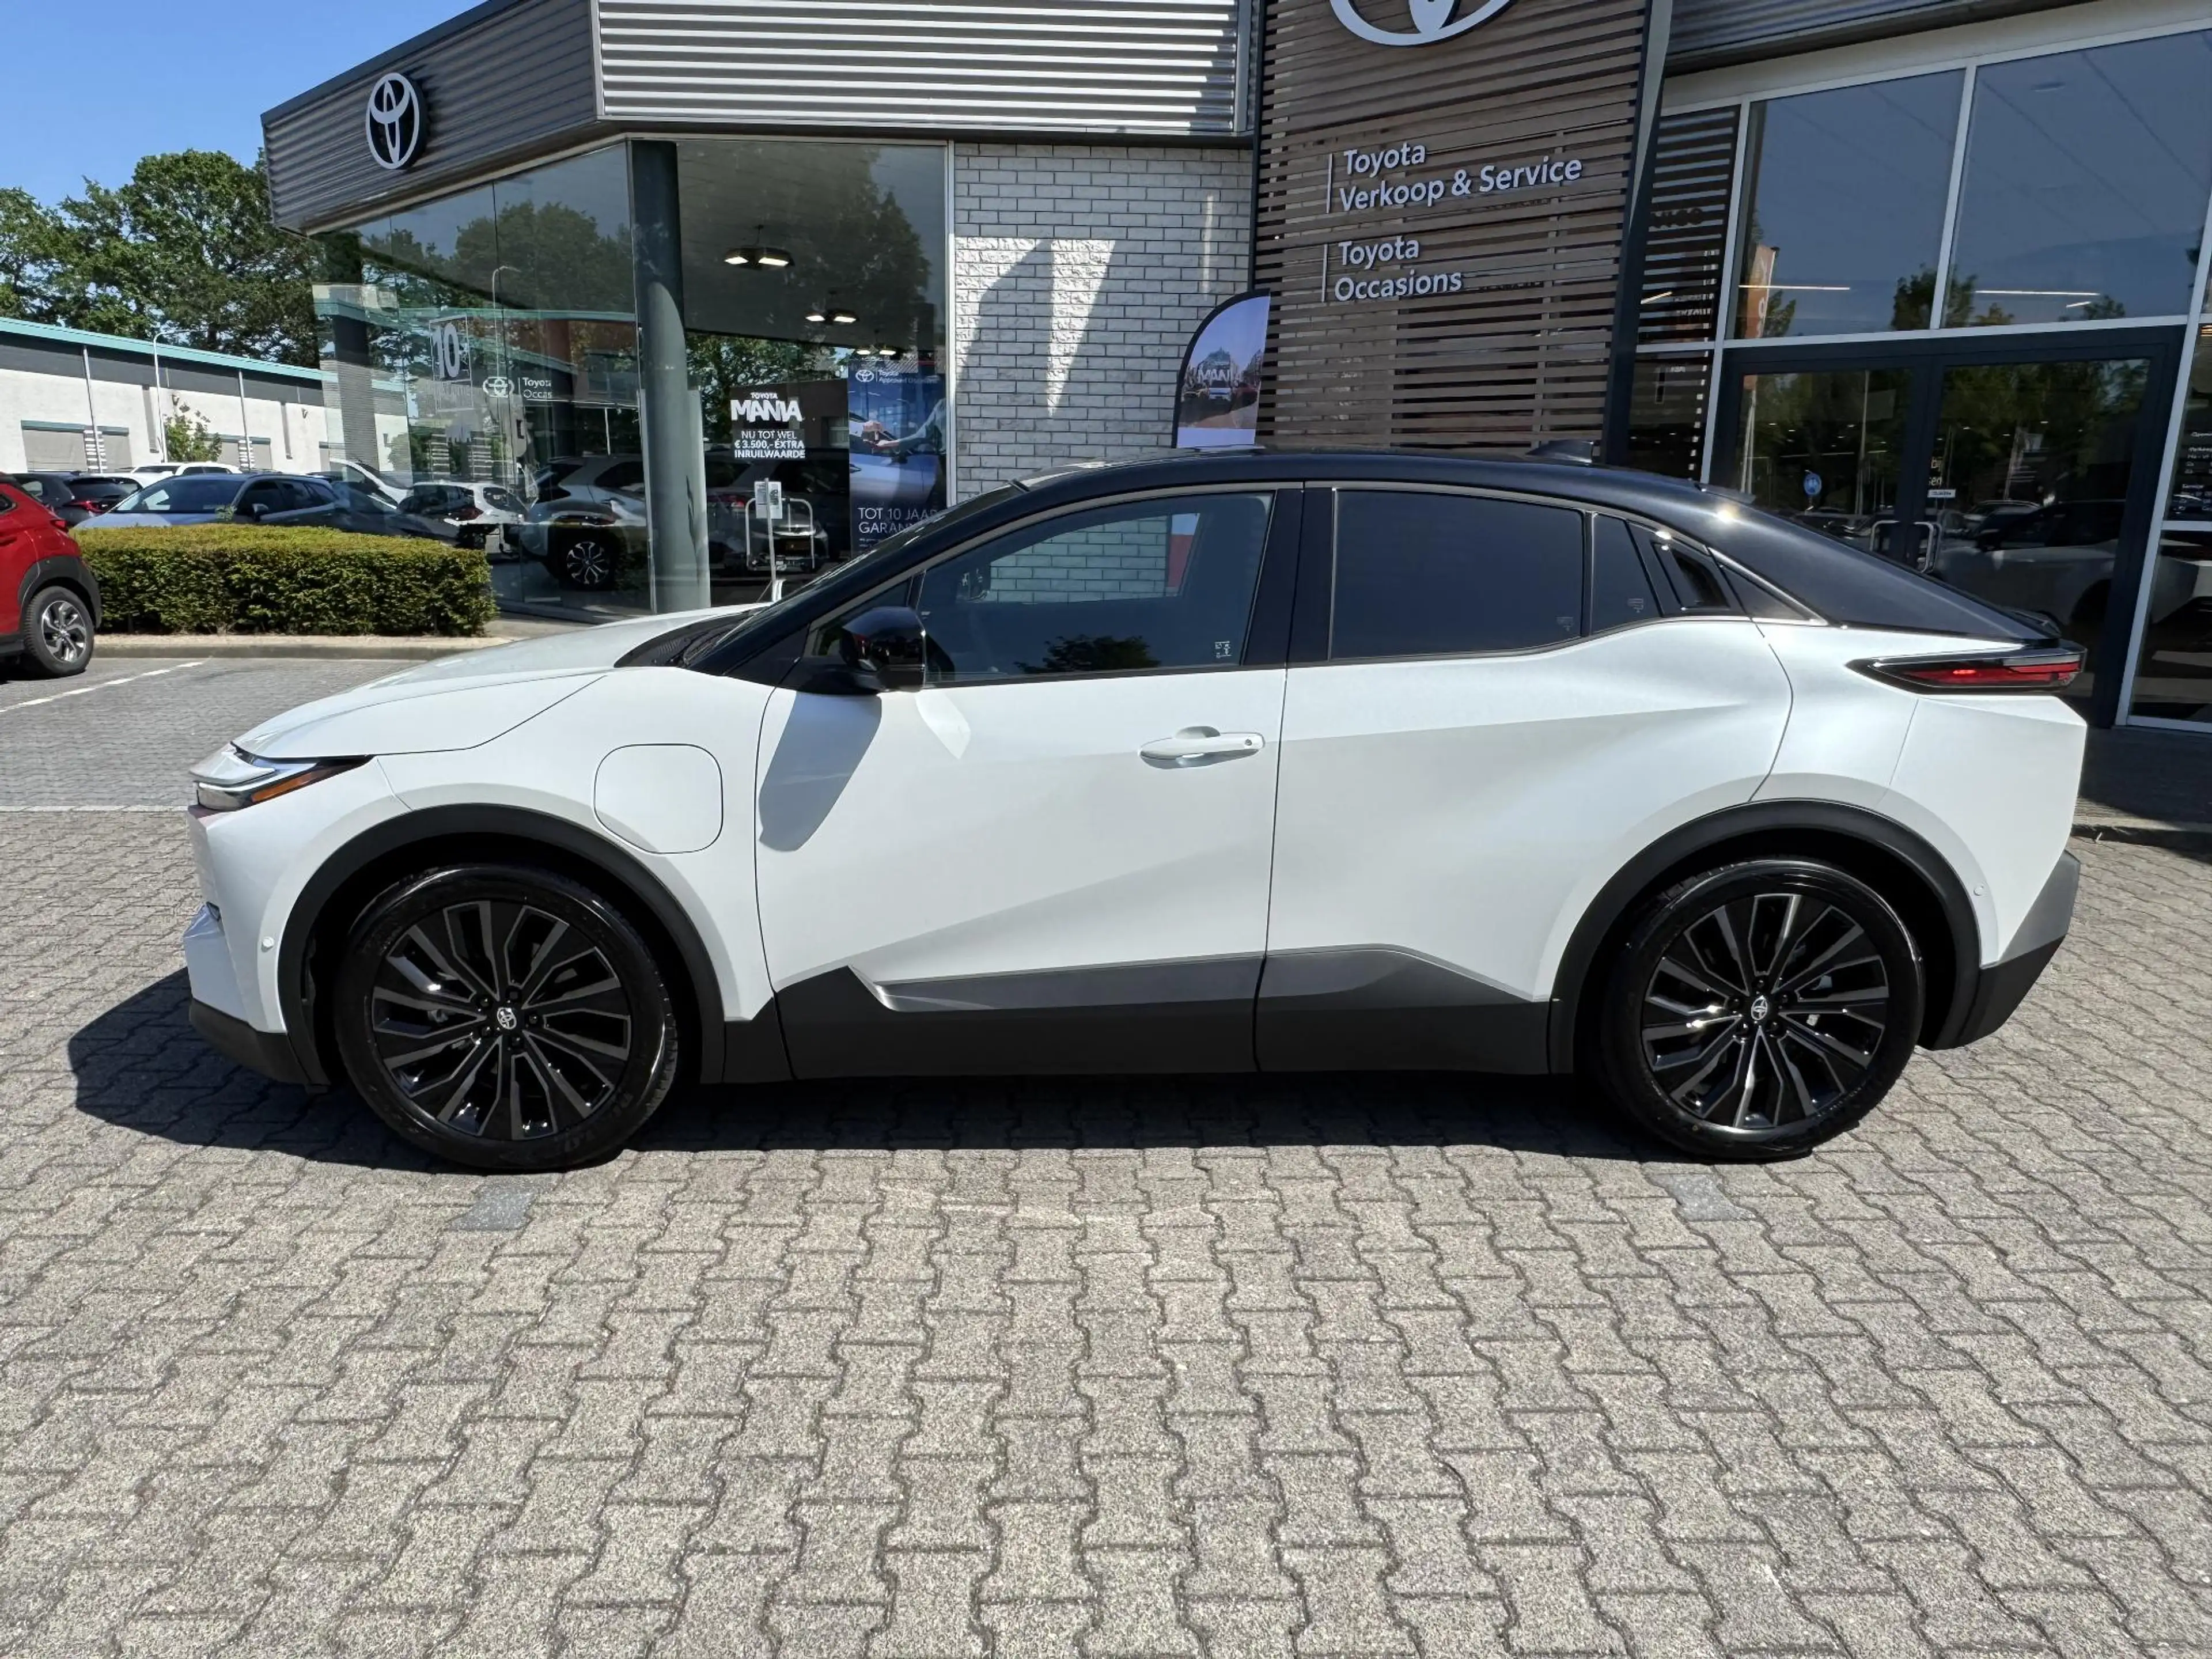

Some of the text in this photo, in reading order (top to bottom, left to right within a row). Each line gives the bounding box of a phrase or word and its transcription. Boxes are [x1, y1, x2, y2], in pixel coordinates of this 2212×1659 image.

[1344, 142, 1426, 178] Toyota
[1339, 156, 1582, 211] Verkoop & Service
[1338, 236, 1420, 270] Toyota
[1335, 268, 1462, 301] Occasions
[730, 399, 803, 422] MANIA
[741, 431, 797, 439] NU TOT WEL
[734, 449, 806, 459] INRUILWAARDE
[858, 507, 884, 520] TOT
[888, 508, 901, 520] 10
